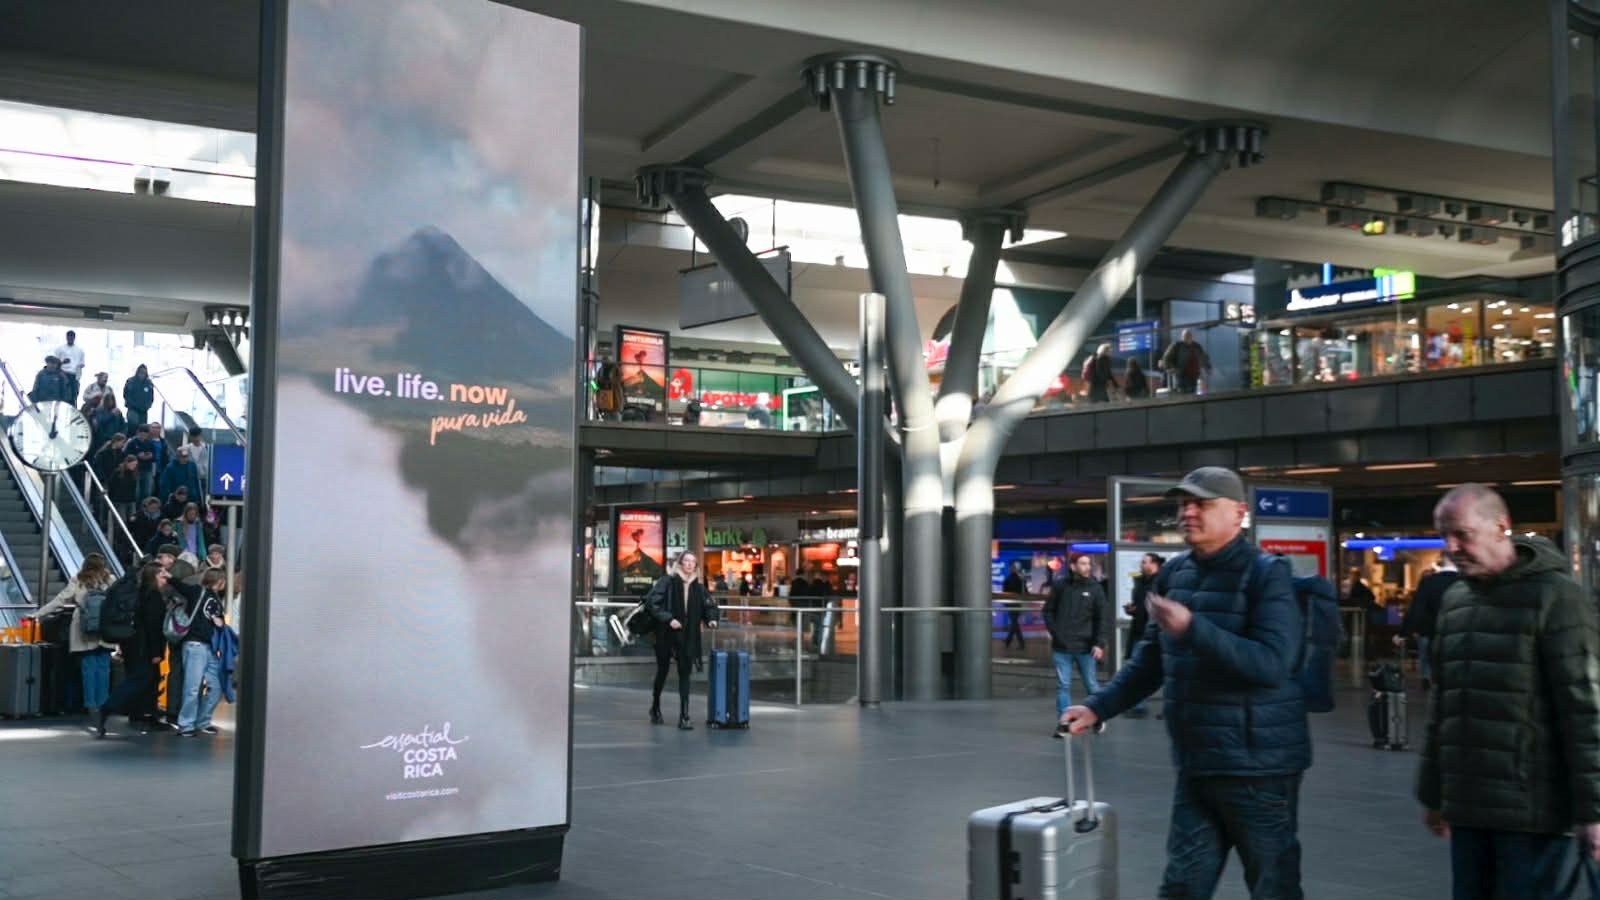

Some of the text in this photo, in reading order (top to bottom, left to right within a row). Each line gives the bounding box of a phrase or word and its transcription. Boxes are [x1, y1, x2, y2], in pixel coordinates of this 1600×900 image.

[334, 367, 508, 406] live. life. now
[430, 399, 528, 446] pura vida
[360, 721, 470, 753] essential
[403, 746, 457, 764] COSTA
[403, 762, 443, 780] RICA
